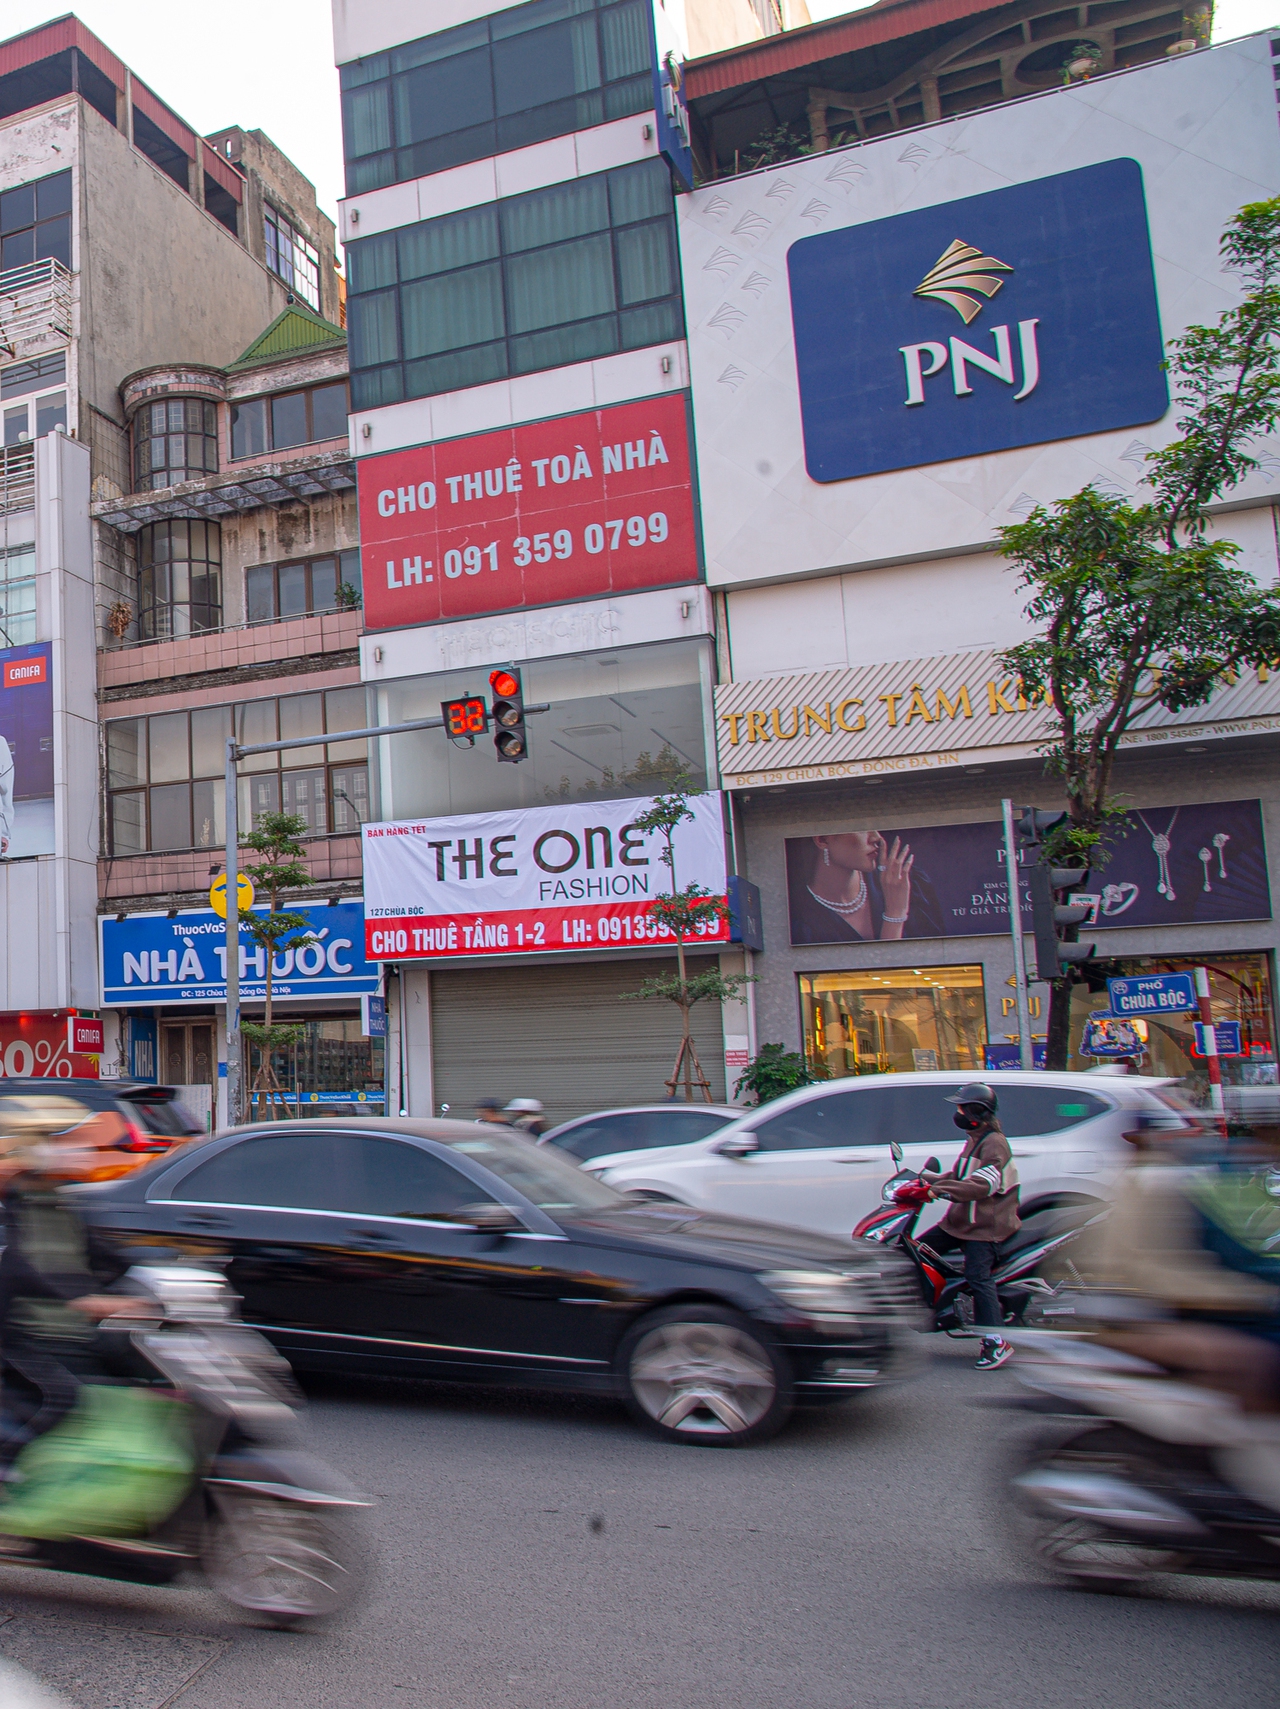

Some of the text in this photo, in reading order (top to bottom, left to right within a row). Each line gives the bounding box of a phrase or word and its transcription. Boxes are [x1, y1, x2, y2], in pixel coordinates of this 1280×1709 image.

[898, 317, 1040, 407] PNJ
[377, 430, 669, 517] CHO THUÊ TOÀ NHÀ
[386, 511, 668, 589] LH: 091 359 0799
[9, 664, 40, 680] CANIFA
[449, 700, 483, 735] 32
[722, 698, 866, 745] TRUNG
[878, 683, 972, 727] TÂM
[1146, 732, 1168, 742] 1800
[762, 773, 782, 784] 129
[787, 767, 824, 781] CHÙA
[938, 753, 959, 765] HN
[411, 823, 427, 835] TẾT
[428, 835, 518, 881] THE
[997, 849, 1025, 863] PJ
[539, 873, 649, 901] FASHION
[971, 890, 1009, 905] ĐẲN
[408, 905, 424, 916] BỘC
[372, 929, 408, 954] CHO
[412, 922, 458, 950] THUÊ
[463, 917, 509, 948] TẦNG
[515, 921, 545, 946] 1-2
[562, 919, 592, 943] LH:
[598, 914, 719, 941] 09135999
[123, 927, 354, 984] NHÀ THUỐC
[195, 987, 205, 996] 125
[207, 986, 223, 997] Chùa
[1138, 978, 1163, 991] PHỐ
[1121, 989, 1186, 1010] CHÙA BỘC
[77, 1028, 100, 1044] CANIFA
[134, 1034, 154, 1078] NHÀ
